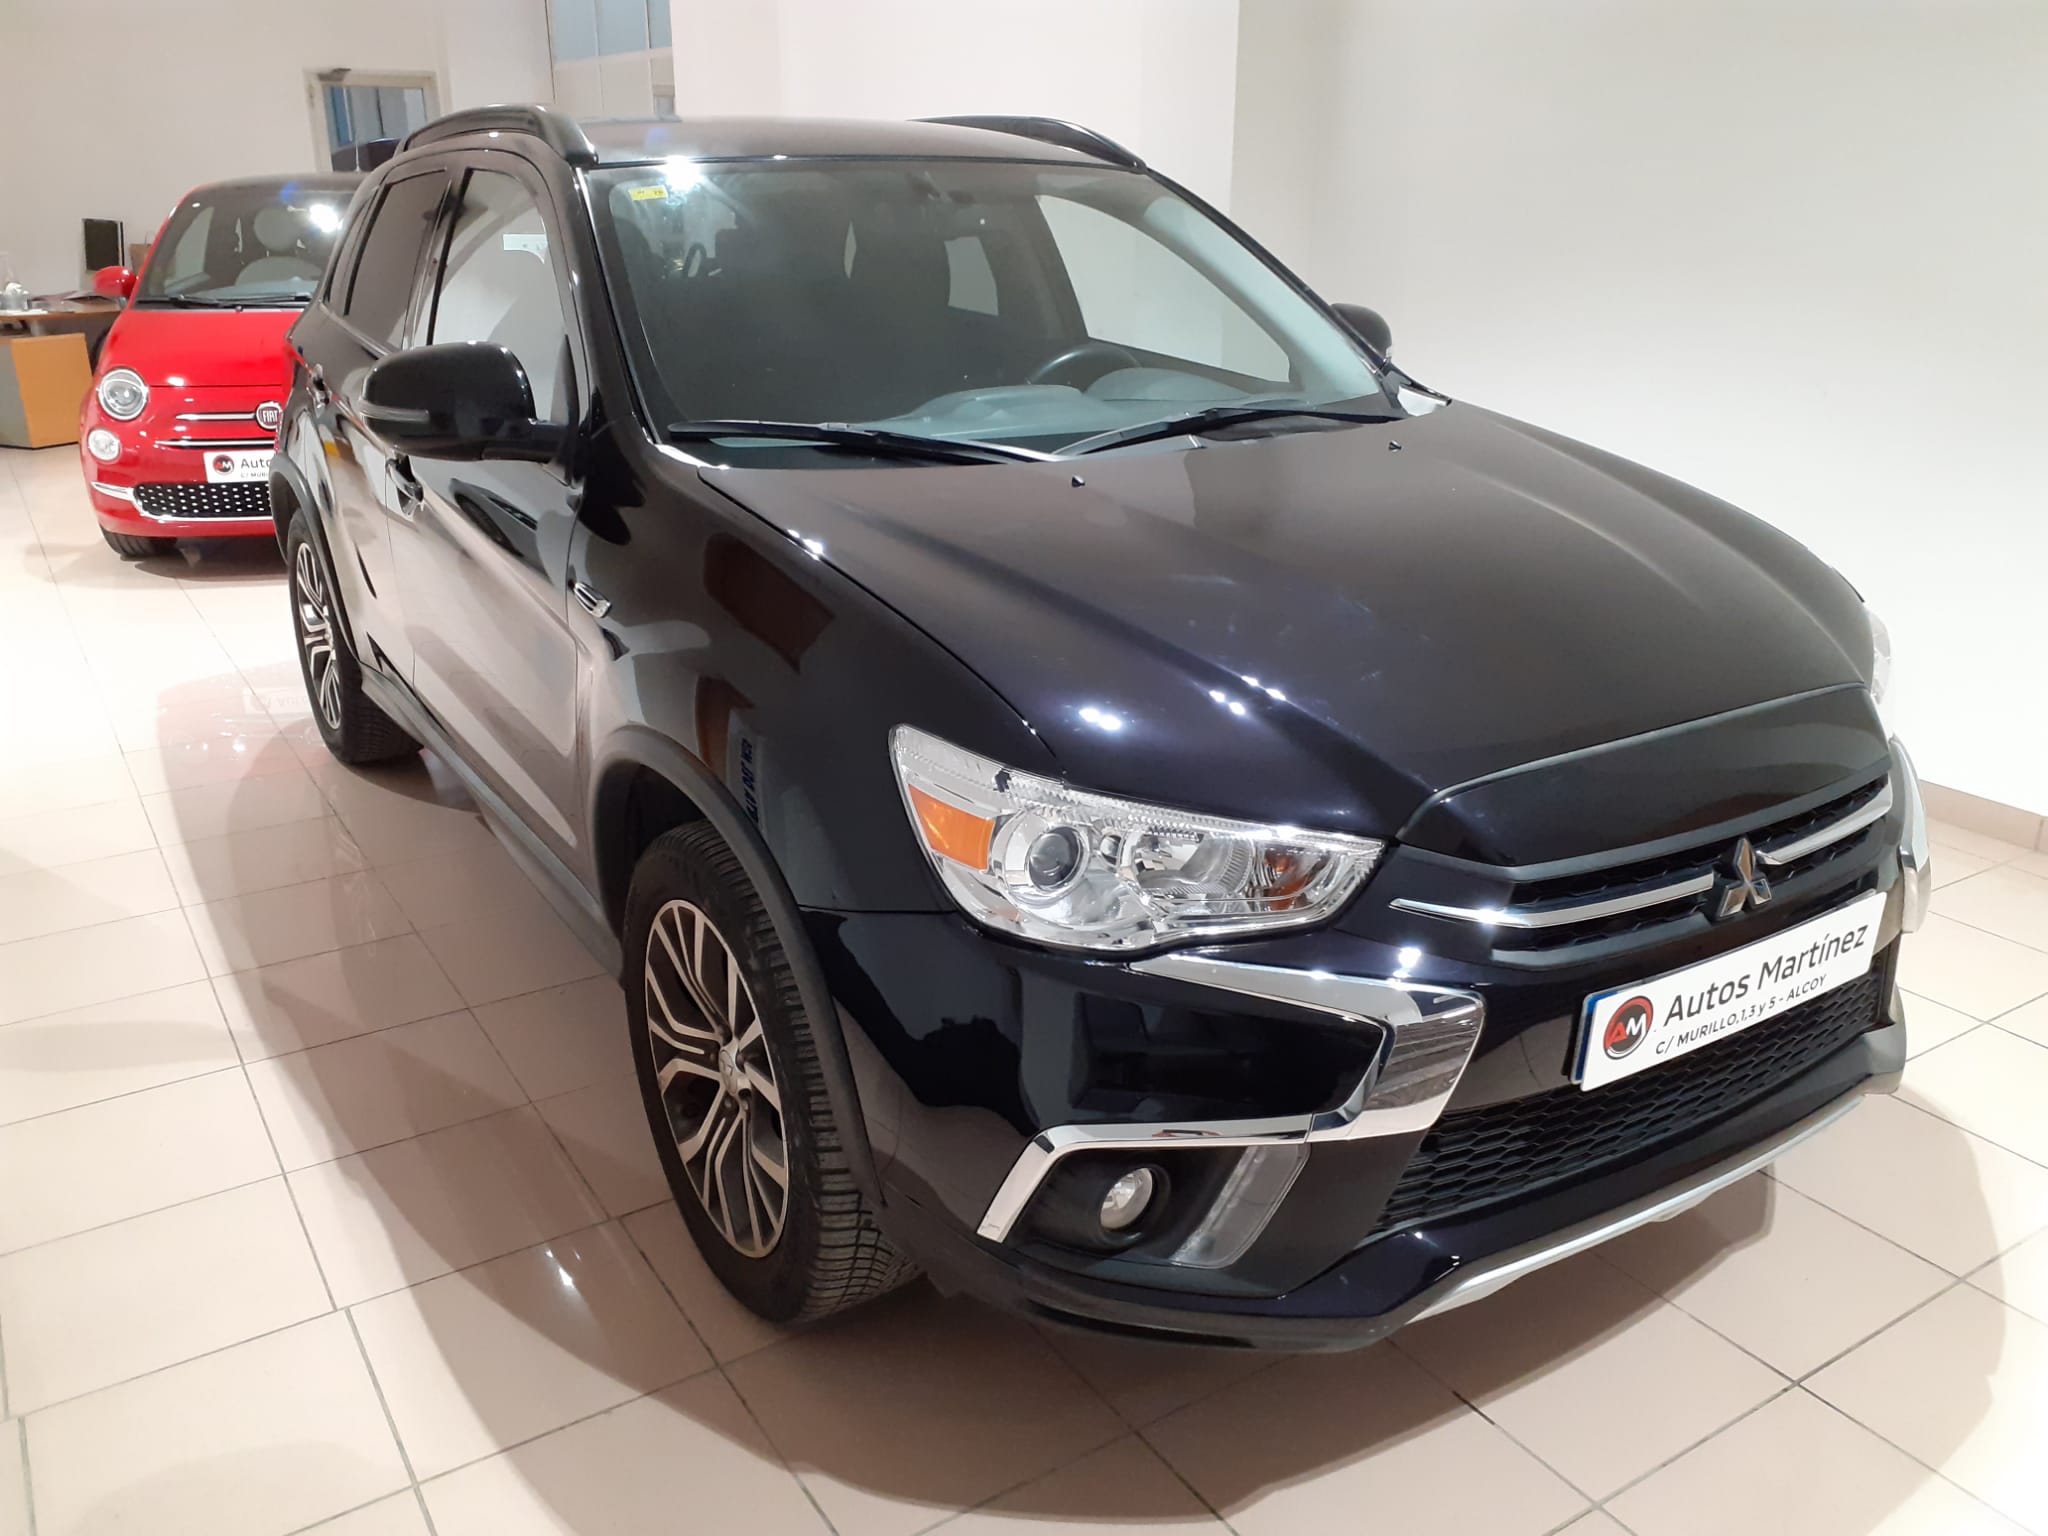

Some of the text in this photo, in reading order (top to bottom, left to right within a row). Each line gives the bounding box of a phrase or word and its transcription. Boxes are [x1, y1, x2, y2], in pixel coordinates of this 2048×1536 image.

[263, 410, 278, 423] FIAT
[1664, 924, 1868, 1026] Autos Martínez
[1605, 1017, 1647, 1043] AM
[1655, 1036, 1676, 1055] C/
[1757, 1003, 1767, 1017] y
[1768, 996, 1776, 1009] 5
[1786, 974, 1826, 1000] ALCOY
